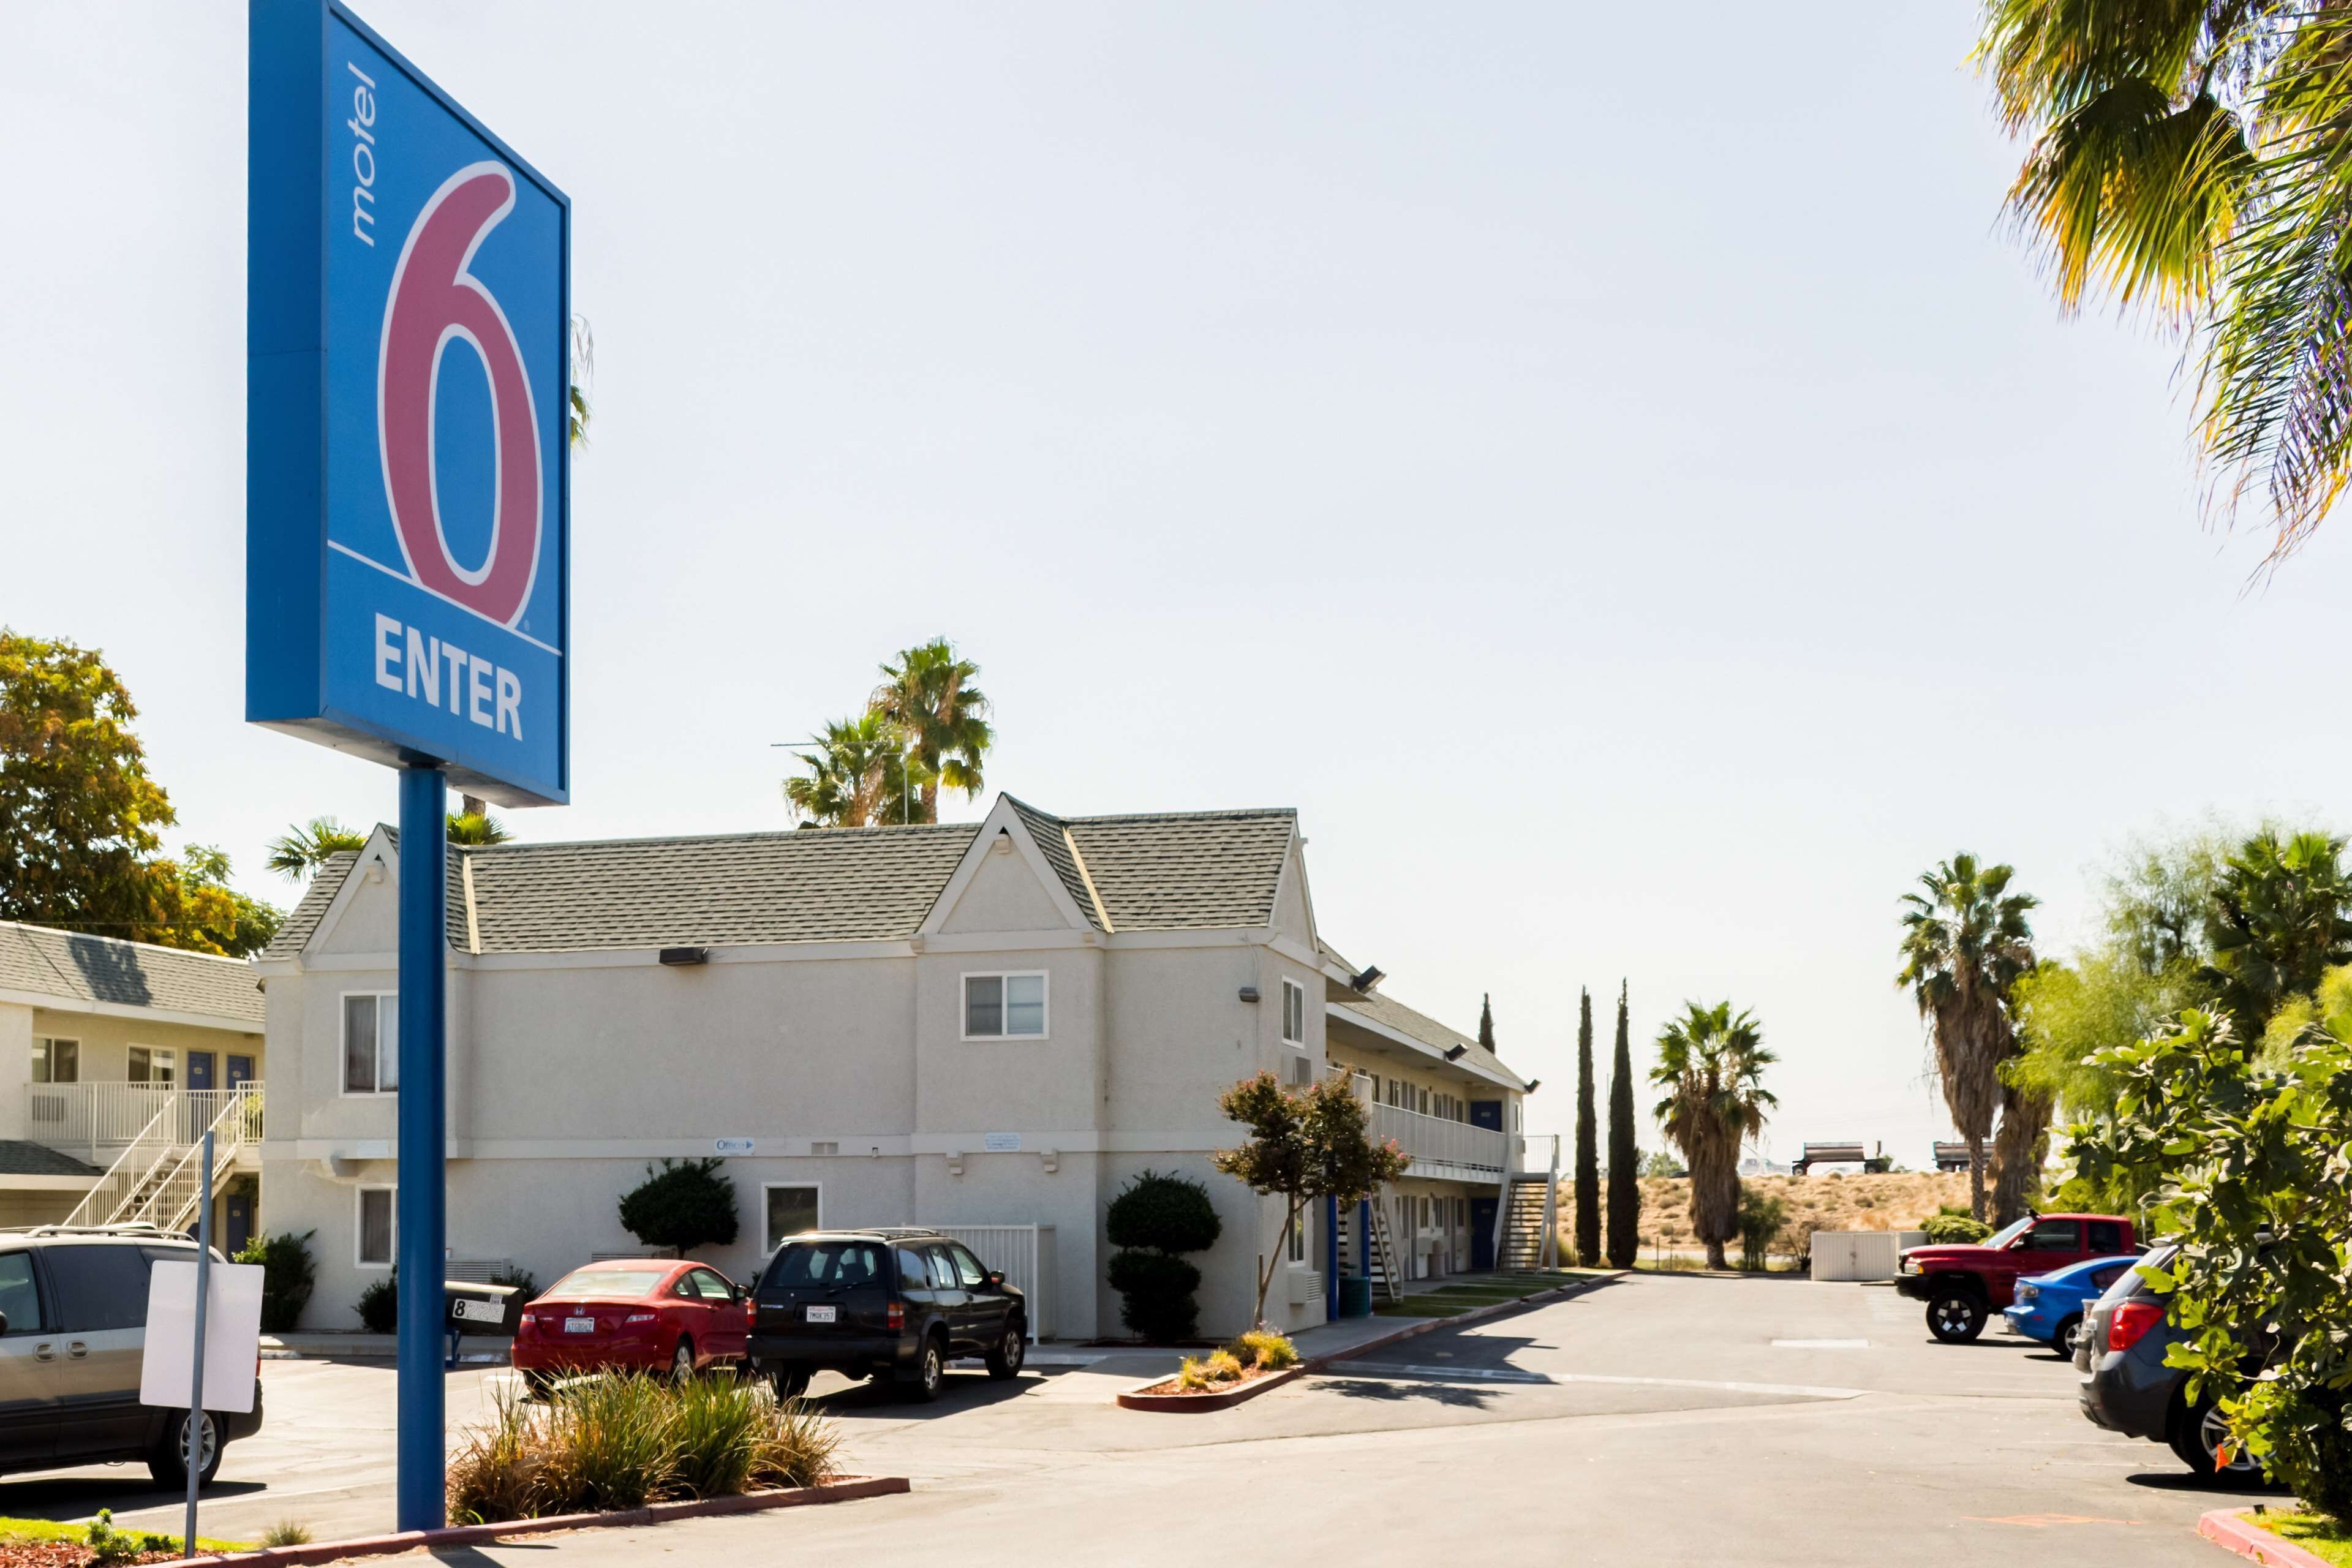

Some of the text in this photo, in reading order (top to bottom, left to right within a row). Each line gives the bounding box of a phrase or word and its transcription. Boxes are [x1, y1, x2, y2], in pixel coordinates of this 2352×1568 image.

[348, 61, 375, 247] motel
[377, 160, 543, 630] 6
[375, 612, 522, 741] ENTER
[454, 1300, 503, 1322] 8223
